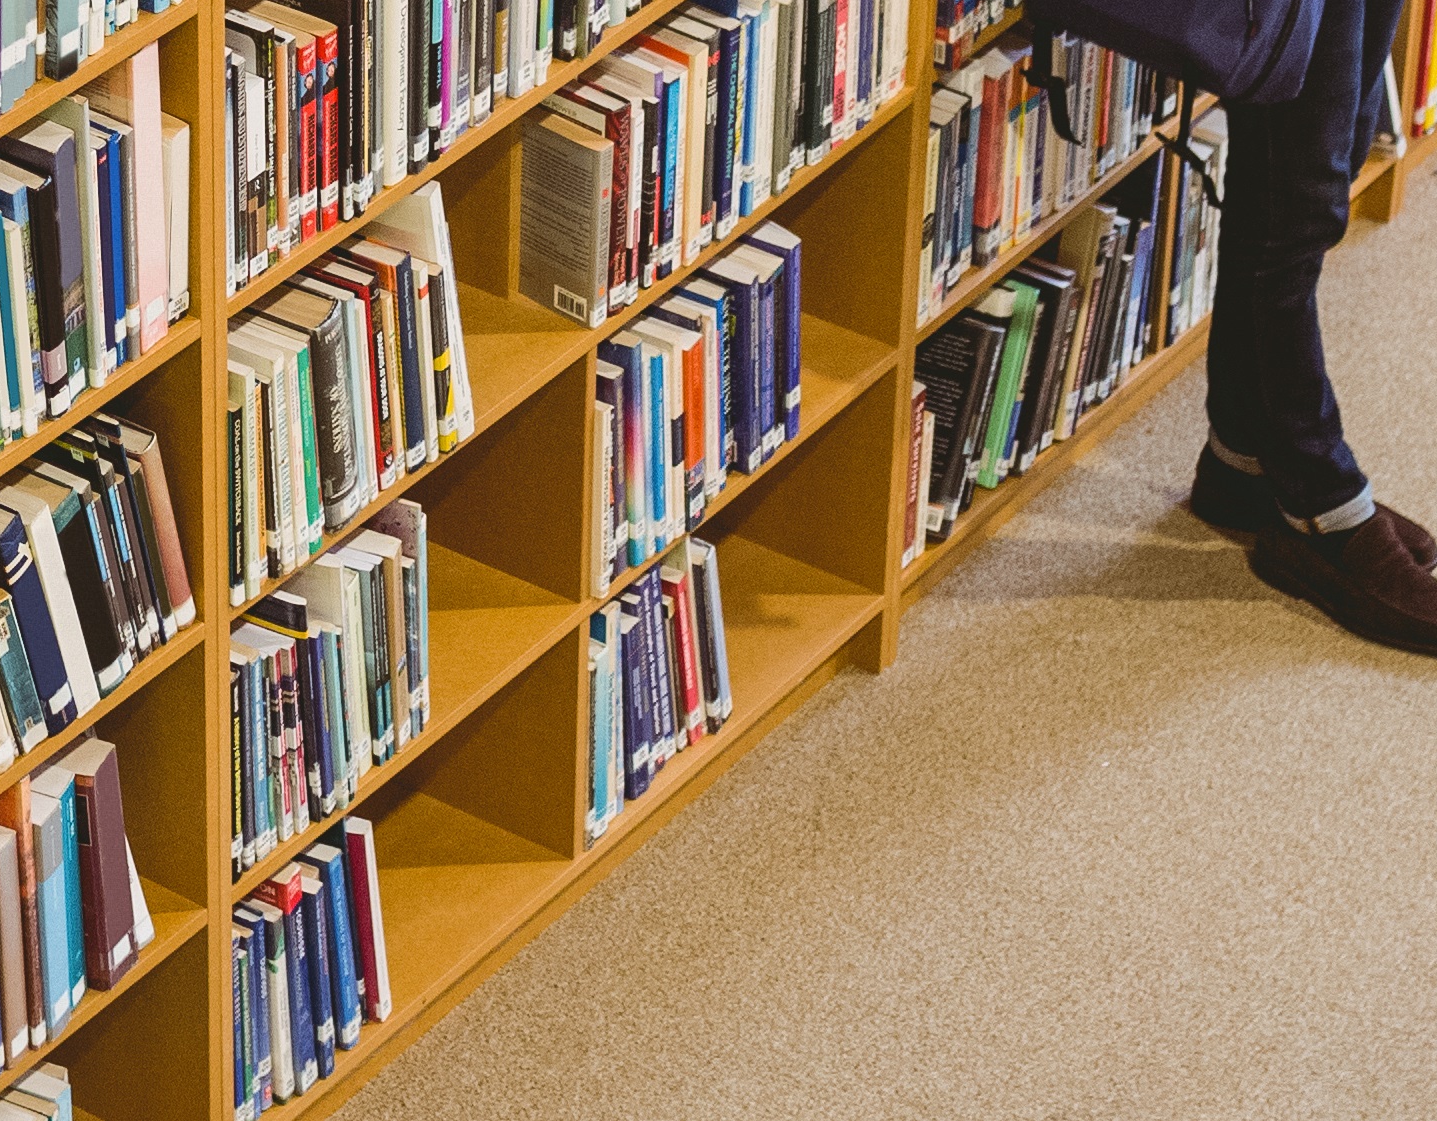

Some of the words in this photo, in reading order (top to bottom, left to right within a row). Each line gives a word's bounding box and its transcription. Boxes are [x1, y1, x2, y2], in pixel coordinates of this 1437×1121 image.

[398, 5, 408, 85] Development
[729, 51, 738, 74] THE
[267, 80, 275, 141] ENTREPRENEURSHIP
[397, 88, 407, 131] Factory
[618, 114, 630, 172] WAVES
[615, 187, 628, 247] POWER
[330, 387, 339, 405] OF
[233, 418, 241, 440] COAL
[331, 406, 344, 454] NATIONS
[234, 452, 242, 464] the
[234, 467, 242, 526] SWITCHBACK
